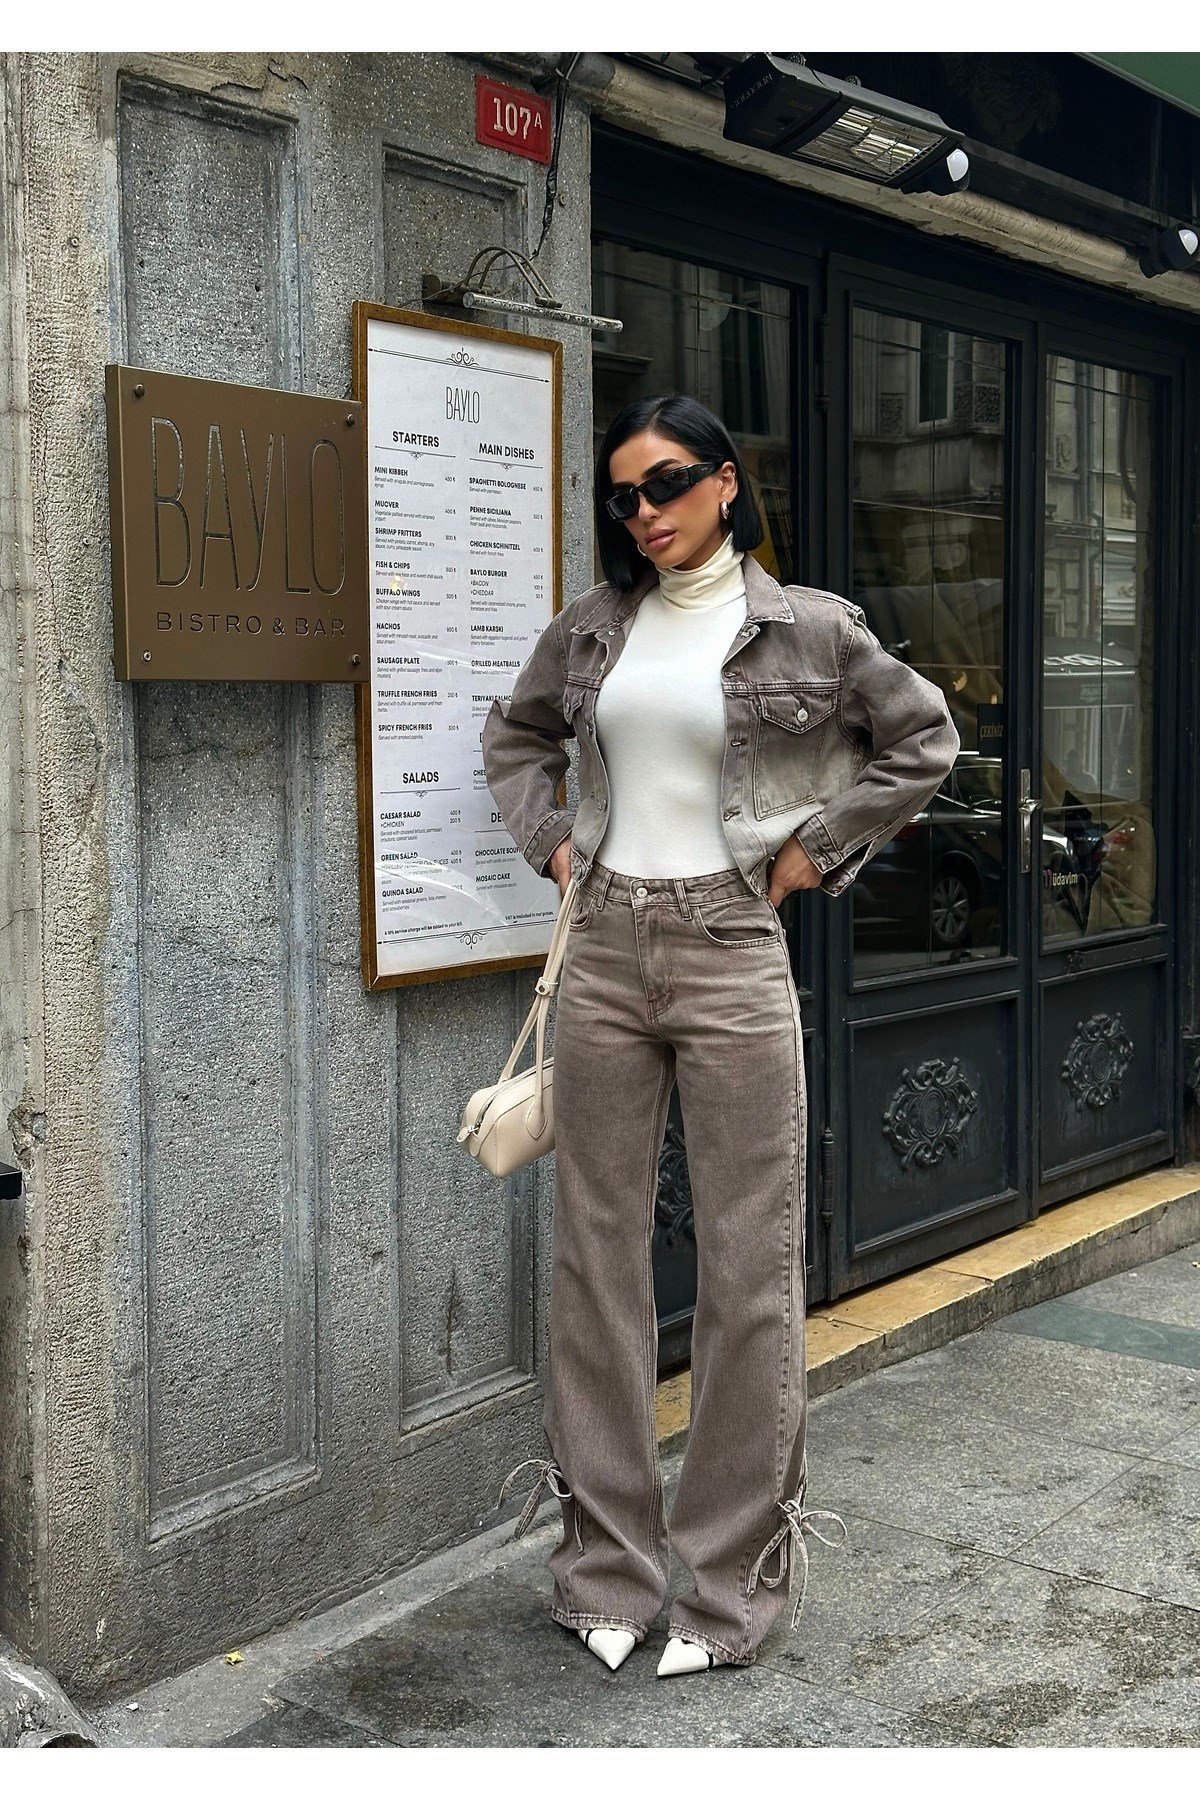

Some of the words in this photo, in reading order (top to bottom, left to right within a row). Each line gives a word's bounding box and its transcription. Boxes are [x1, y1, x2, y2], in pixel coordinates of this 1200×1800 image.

[493, 97, 531, 140] 107
[534, 112, 543, 130] A
[446, 386, 480, 424] BAYLO
[393, 431, 439, 447] STARTERS
[479, 443, 502, 456] MAIN
[505, 446, 534, 459] DISHES
[389, 468, 408, 476] KIBBEH
[469, 477, 496, 486] SPAGHETTI
[498, 481, 526, 490] BOLOGNESE
[152, 417, 346, 595] BAYLO
[487, 508, 511, 516] SICILIANA
[157, 612, 262, 635] BISTRO
[272, 618, 285, 635] &
[295, 618, 346, 637] BAR
[403, 771, 439, 783] SALADS
[475, 848, 505, 856] CHOCOLATE
[476, 874, 496, 882] MOSAIC
[382, 889, 405, 897] QUINOA
[406, 887, 423, 895] SALAD
